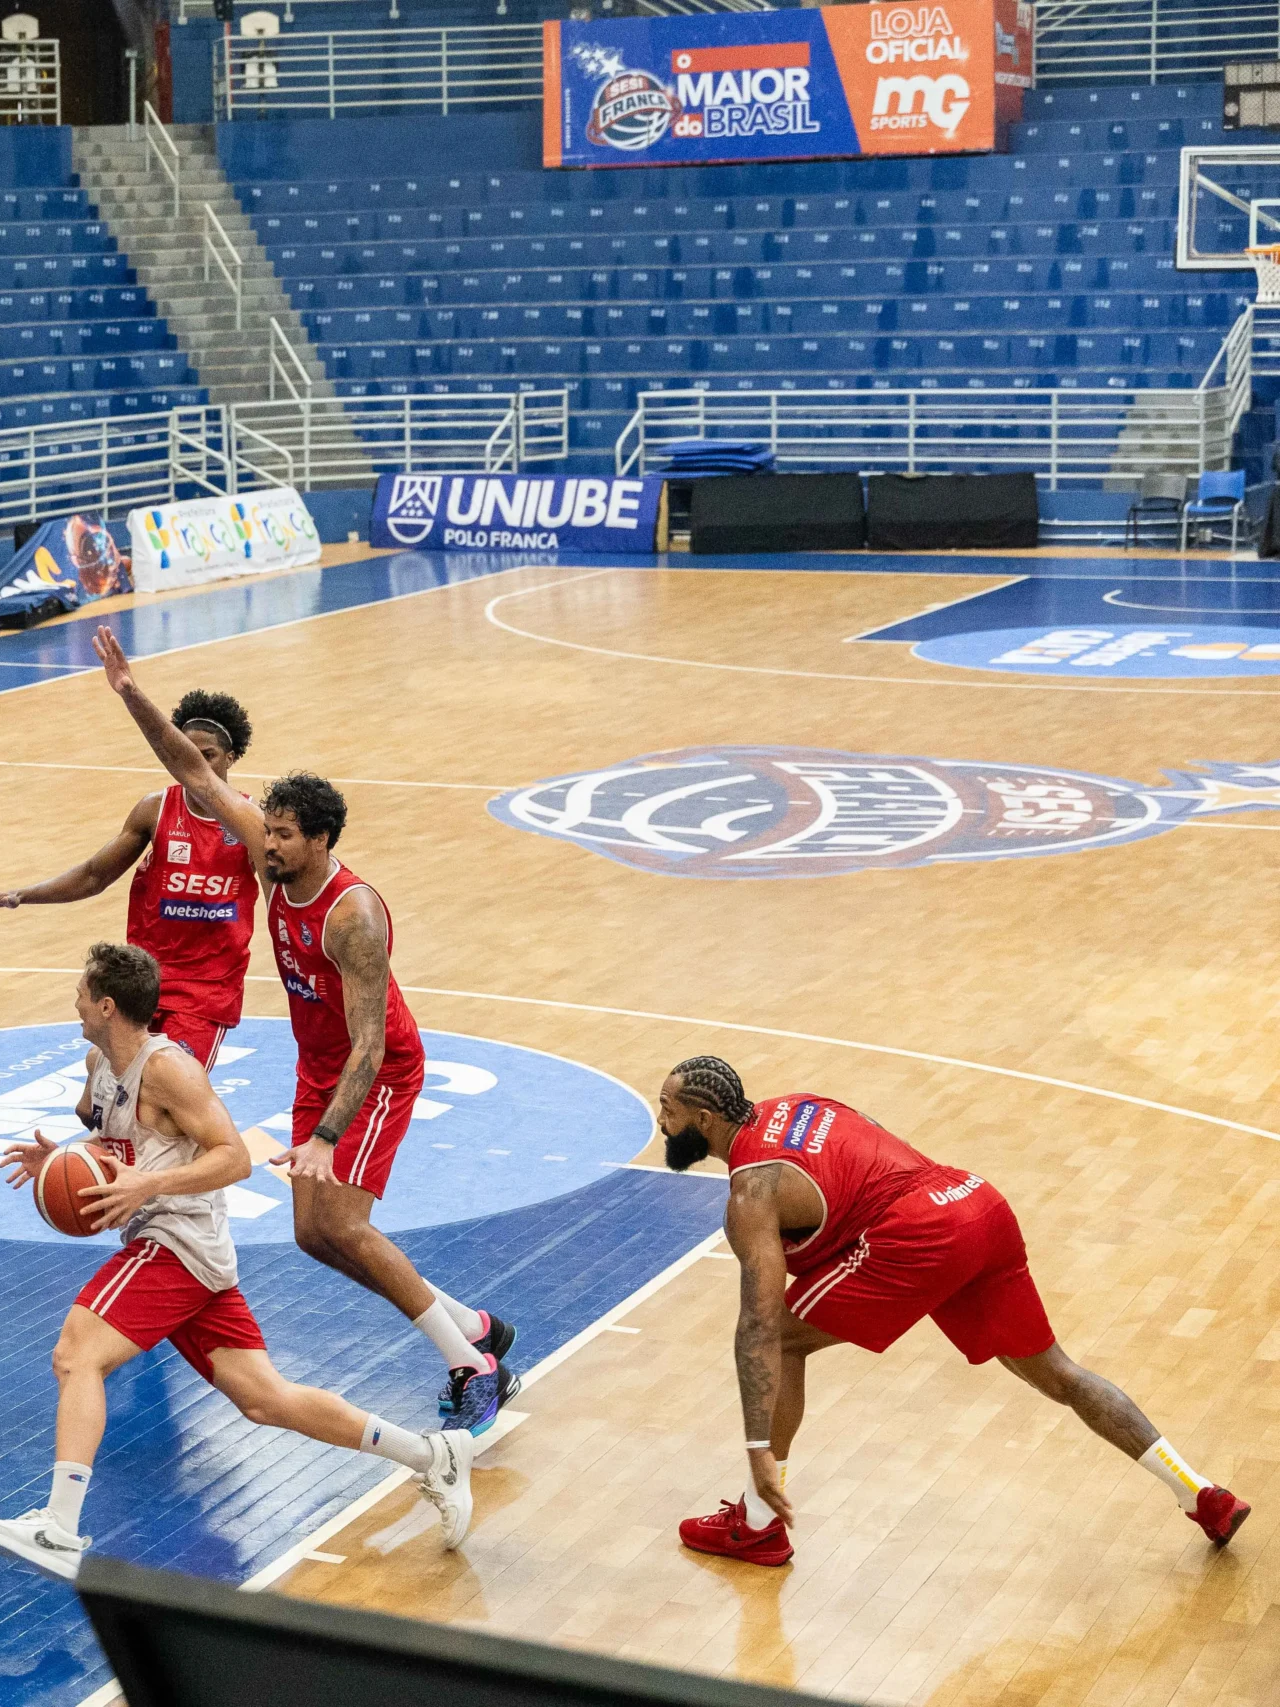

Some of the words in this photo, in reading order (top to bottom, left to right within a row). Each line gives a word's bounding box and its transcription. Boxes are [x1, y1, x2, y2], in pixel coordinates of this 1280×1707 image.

[871, 7, 953, 39] LOJA
[866, 36, 969, 64] OFICIAL
[609, 77, 646, 97] SESI
[677, 67, 810, 107] MAIOR
[599, 91, 668, 127] FRANCA
[674, 115, 703, 137] do
[704, 101, 820, 138] BRASIL
[870, 114, 928, 130] SPORTS
[446, 477, 643, 529] UNIUBE
[444, 529, 487, 547] POLO
[490, 531, 559, 550] FRANCA
[760, 767, 948, 855] FRANCA
[986, 780, 1096, 834] SESI
[167, 872, 233, 896] SESI
[8, 1047, 65, 1072] LADO
[763, 1101, 791, 1143] FIESP
[807, 1107, 836, 1154] Unimed
[928, 1172, 986, 1206] Unimed
